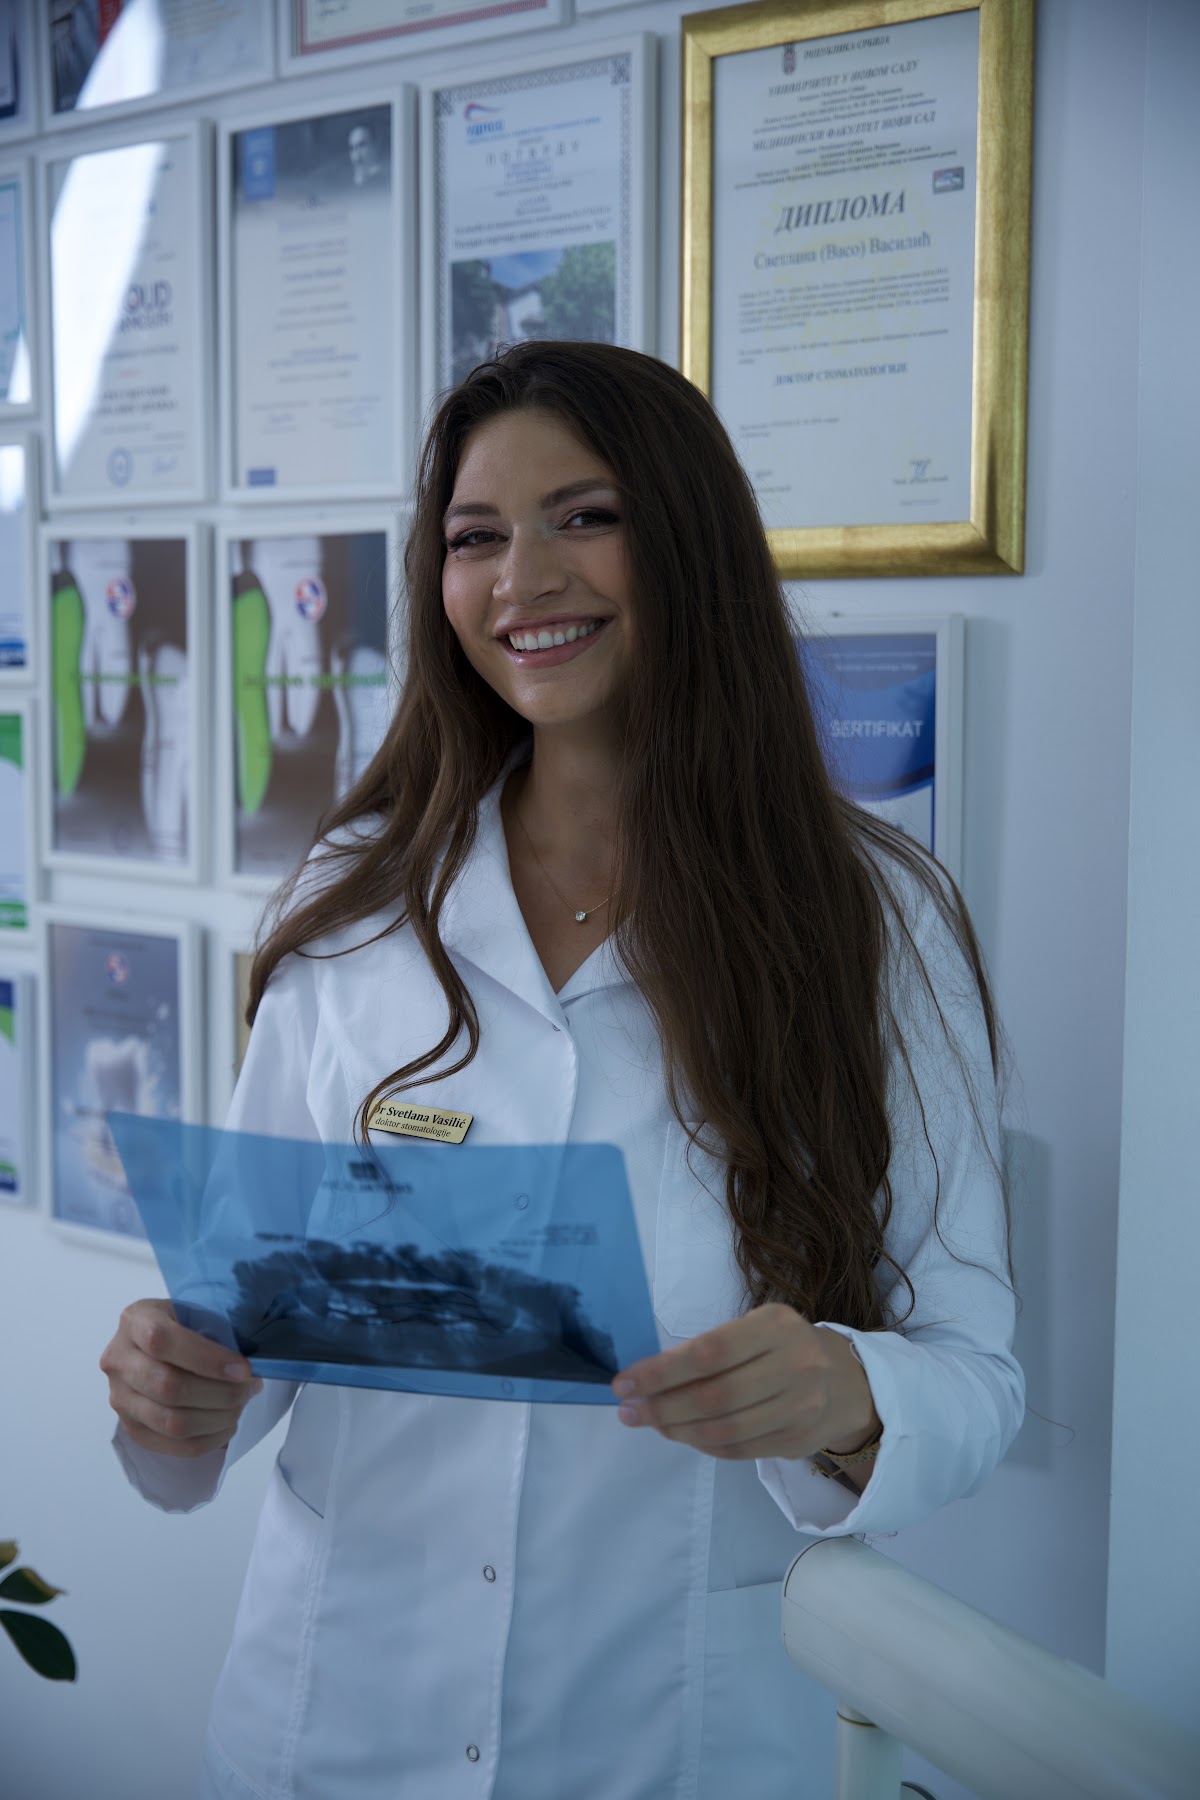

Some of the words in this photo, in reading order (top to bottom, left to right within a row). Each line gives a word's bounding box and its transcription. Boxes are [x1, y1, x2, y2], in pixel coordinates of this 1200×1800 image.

[774, 190, 906, 235] ДИПЛОМА
[869, 231, 931, 254] Василић
[830, 719, 924, 739] SERTIFIKAT
[375, 1117, 400, 1129] doktor
[401, 1123, 452, 1138] stomatologije
[386, 1107, 430, 1123] Svetlana
[432, 1114, 466, 1129] Vasilić
